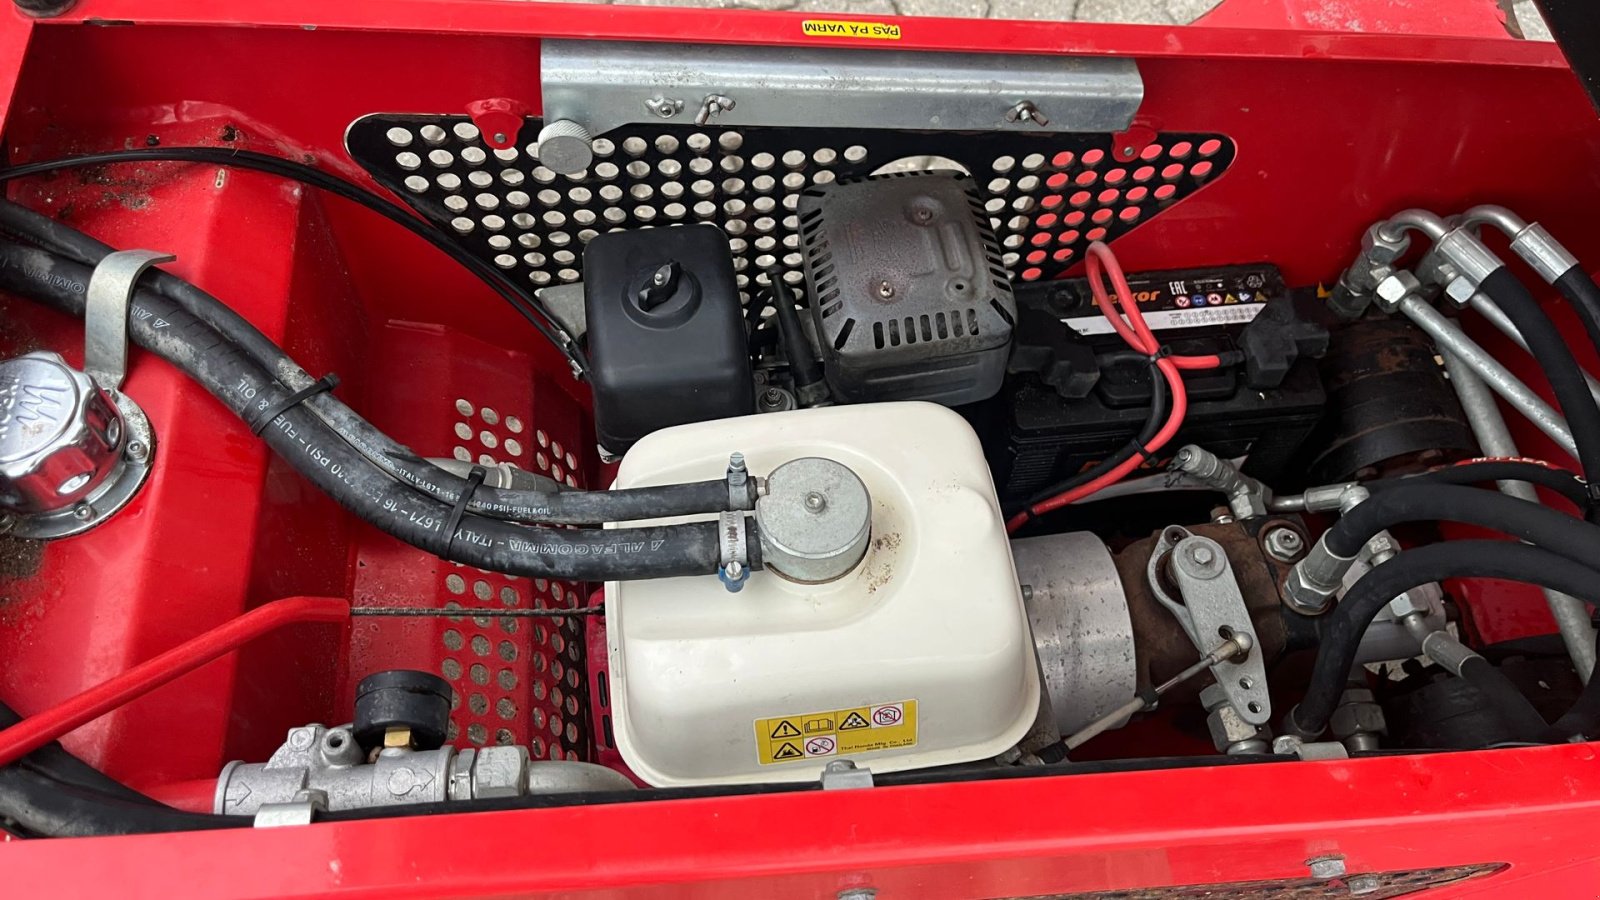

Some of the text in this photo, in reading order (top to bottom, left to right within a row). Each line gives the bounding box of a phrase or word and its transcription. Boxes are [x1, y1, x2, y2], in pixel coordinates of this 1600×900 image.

[804, 23, 899, 36] PAS PÅ VARM
[236, 378, 257, 399] OIL
[258, 397, 270, 411] &
[273, 413, 299, 440] FUE
[304, 443, 331, 468] PSI)
[383, 498, 398, 515] 16
[409, 511, 442, 532] L671
[453, 528, 493, 548] ITALY
[508, 538, 646, 555] ALFAGOMMA
